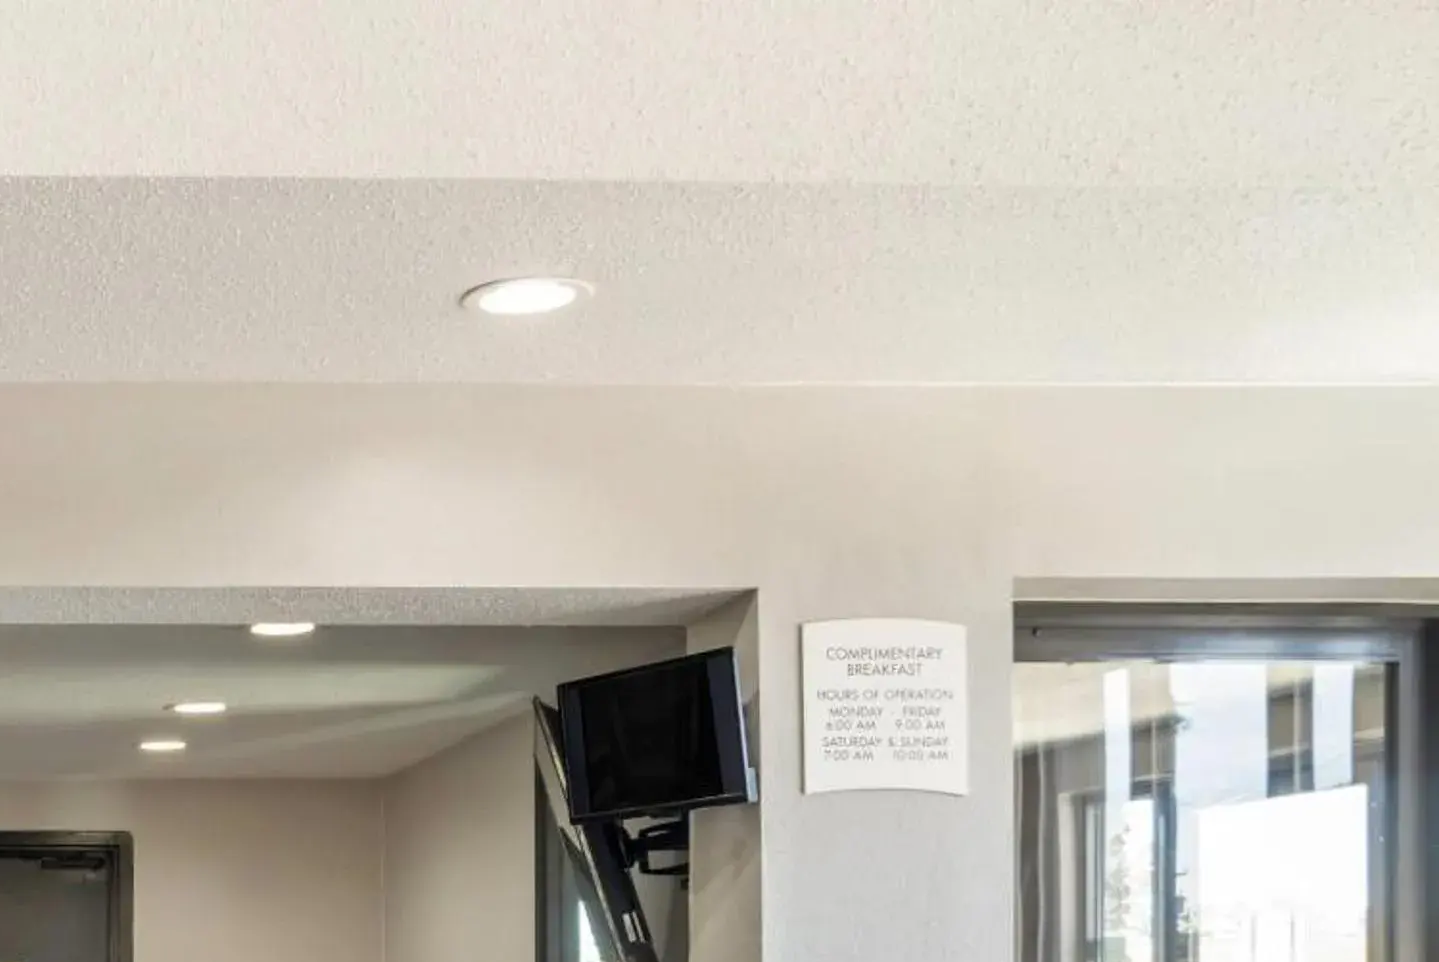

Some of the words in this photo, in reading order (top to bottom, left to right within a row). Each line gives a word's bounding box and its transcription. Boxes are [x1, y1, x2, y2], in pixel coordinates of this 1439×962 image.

[825, 646, 943, 661] COMPLIMENTARY
[846, 662, 924, 677] BREAKFAST
[816, 687, 860, 701] HOURS
[862, 687, 879, 700] OF
[883, 687, 954, 701] OPERATION
[828, 705, 884, 718] MONDAY
[902, 705, 941, 717] FRIDAY
[856, 719, 877, 731] AM
[925, 719, 946, 730] AM
[821, 735, 882, 747] SATURDAY
[899, 735, 949, 747] SUNDAY
[852, 749, 875, 761] AM
[927, 749, 949, 760] AM
